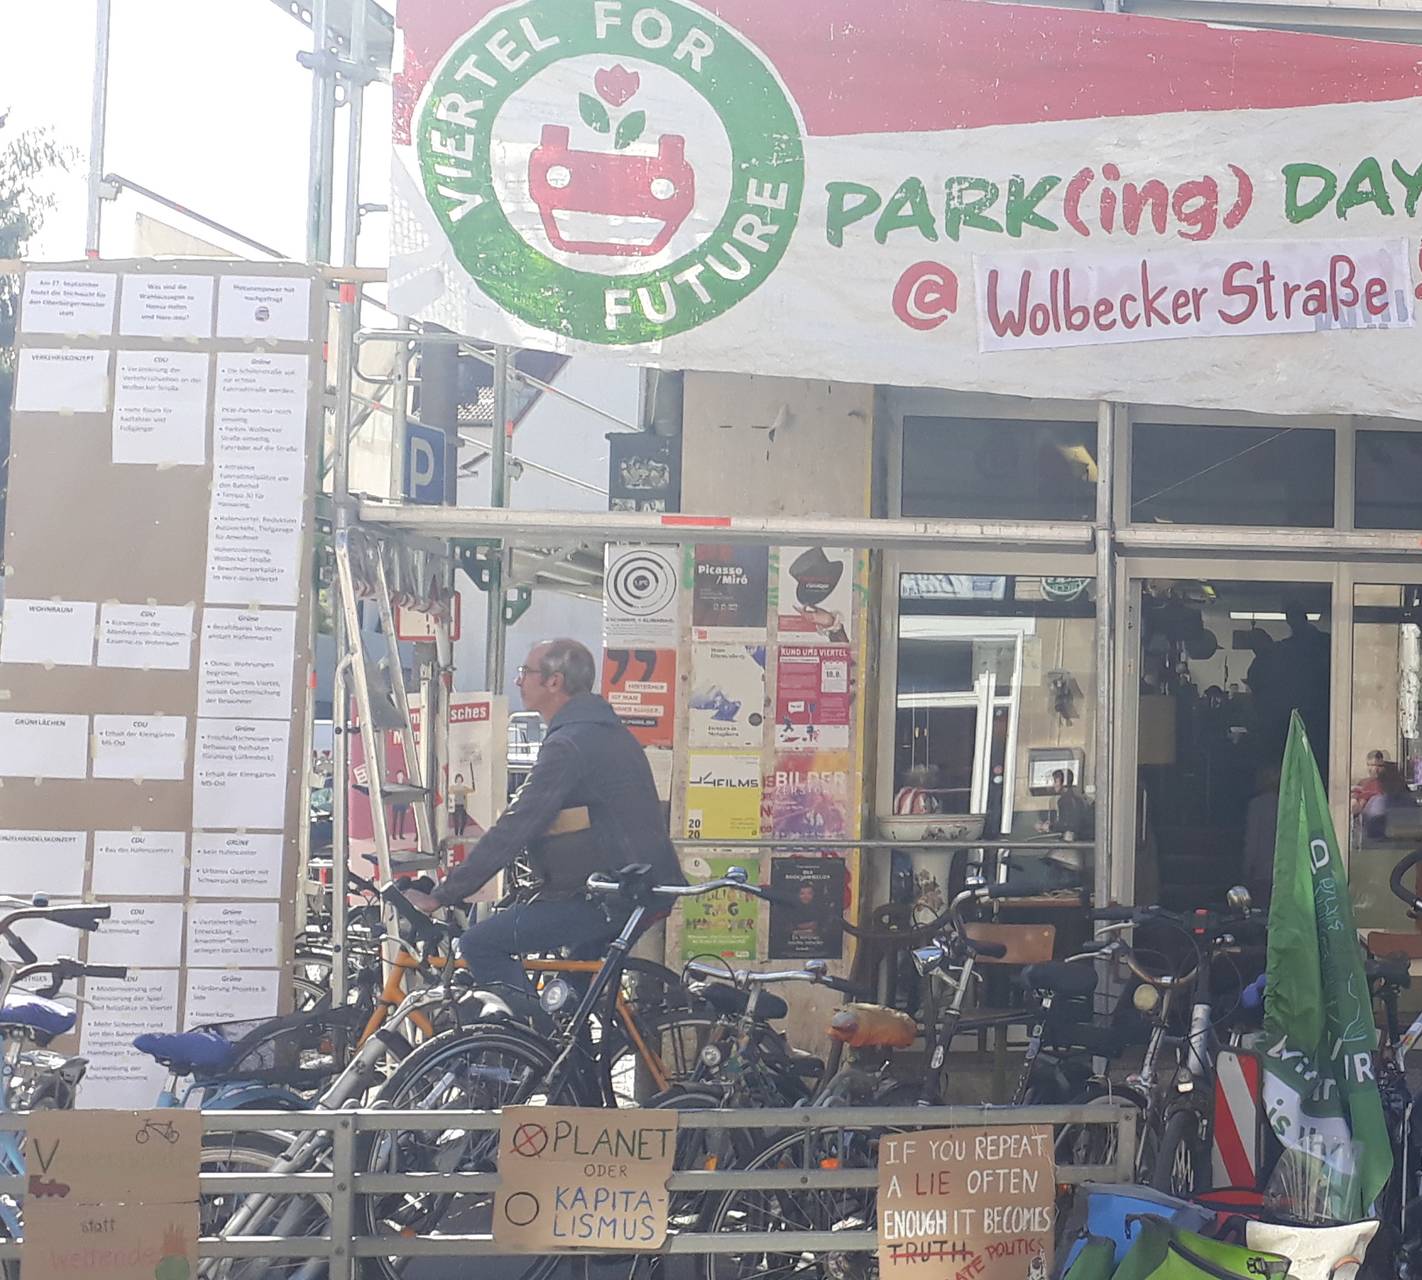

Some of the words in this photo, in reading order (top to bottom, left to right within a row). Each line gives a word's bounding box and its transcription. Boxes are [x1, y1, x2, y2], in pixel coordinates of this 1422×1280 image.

[431, 16, 560, 223] VIERTEL
[594, 1, 716, 72] FOR
[825, 162, 1254, 248] PARK(ing)
[604, 177, 789, 330] FUTURE
[986, 258, 1209, 338] Wolbecker
[1218, 254, 1389, 329] Straße
[410, 436, 435, 498] P
[697, 563, 744, 575] Picasso
[688, 818, 702, 829] 20
[552, 1119, 675, 1161] PLANET
[885, 1139, 918, 1165] IF
[928, 1139, 967, 1162] YOU
[974, 1133, 1050, 1162] REPEAT
[583, 1163, 629, 1178] ODER
[886, 1175, 903, 1200] A
[914, 1170, 952, 1197] LIE
[966, 1166, 1040, 1195] OFTEN
[554, 1185, 666, 1213] KAPITA-
[552, 1213, 656, 1241] LISMUS
[883, 1208, 948, 1240] ENOUGH
[953, 1208, 977, 1235] IT
[982, 1205, 1052, 1235] BECOMES
